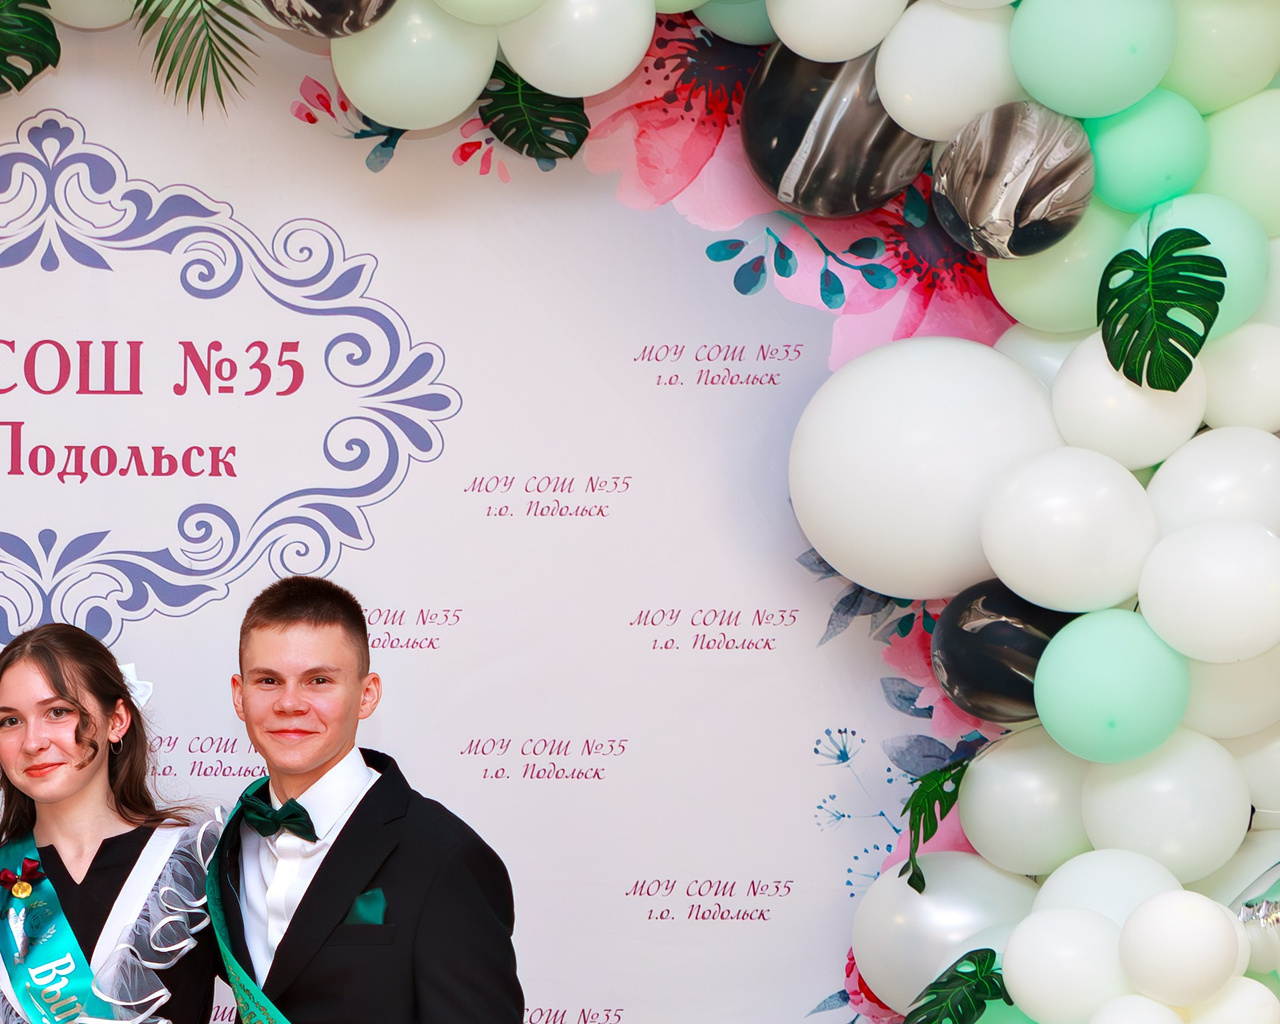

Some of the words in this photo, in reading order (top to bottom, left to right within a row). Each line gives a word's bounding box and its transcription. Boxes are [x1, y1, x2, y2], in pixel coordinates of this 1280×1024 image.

[633, 344, 686, 363] МОУ
[694, 344, 746, 362] СОШ
[755, 343, 804, 362] №35
[172, 339, 305, 397] №35
[655, 373, 685, 386] г.о.
[696, 367, 781, 386] Подольск
[463, 475, 516, 494] МОУ
[524, 475, 575, 494] СОШ
[584, 475, 633, 494] №35
[485, 505, 514, 517] г.о.
[525, 498, 610, 518] Подольск
[362, 608, 407, 627] ОШ
[415, 608, 463, 626] №35
[629, 608, 682, 627] МОУ
[690, 608, 742, 627] СОШ
[751, 609, 800, 627] №35
[652, 638, 680, 651] г.о.
[692, 632, 776, 651] Подольск
[150, 735, 180, 754] ОУ
[187, 736, 238, 755] СОШ
[459, 737, 512, 756] МОУ
[520, 738, 572, 757] СОШ
[580, 738, 629, 757] №35
[189, 759, 268, 778] Подольск
[482, 767, 510, 780] г.о.
[522, 761, 606, 781] Подольск
[624, 879, 677, 897] МОУ
[685, 879, 737, 898] СОШ
[746, 879, 794, 898] №35
[647, 908, 675, 921] г.о.
[687, 902, 770, 922] Подольск
